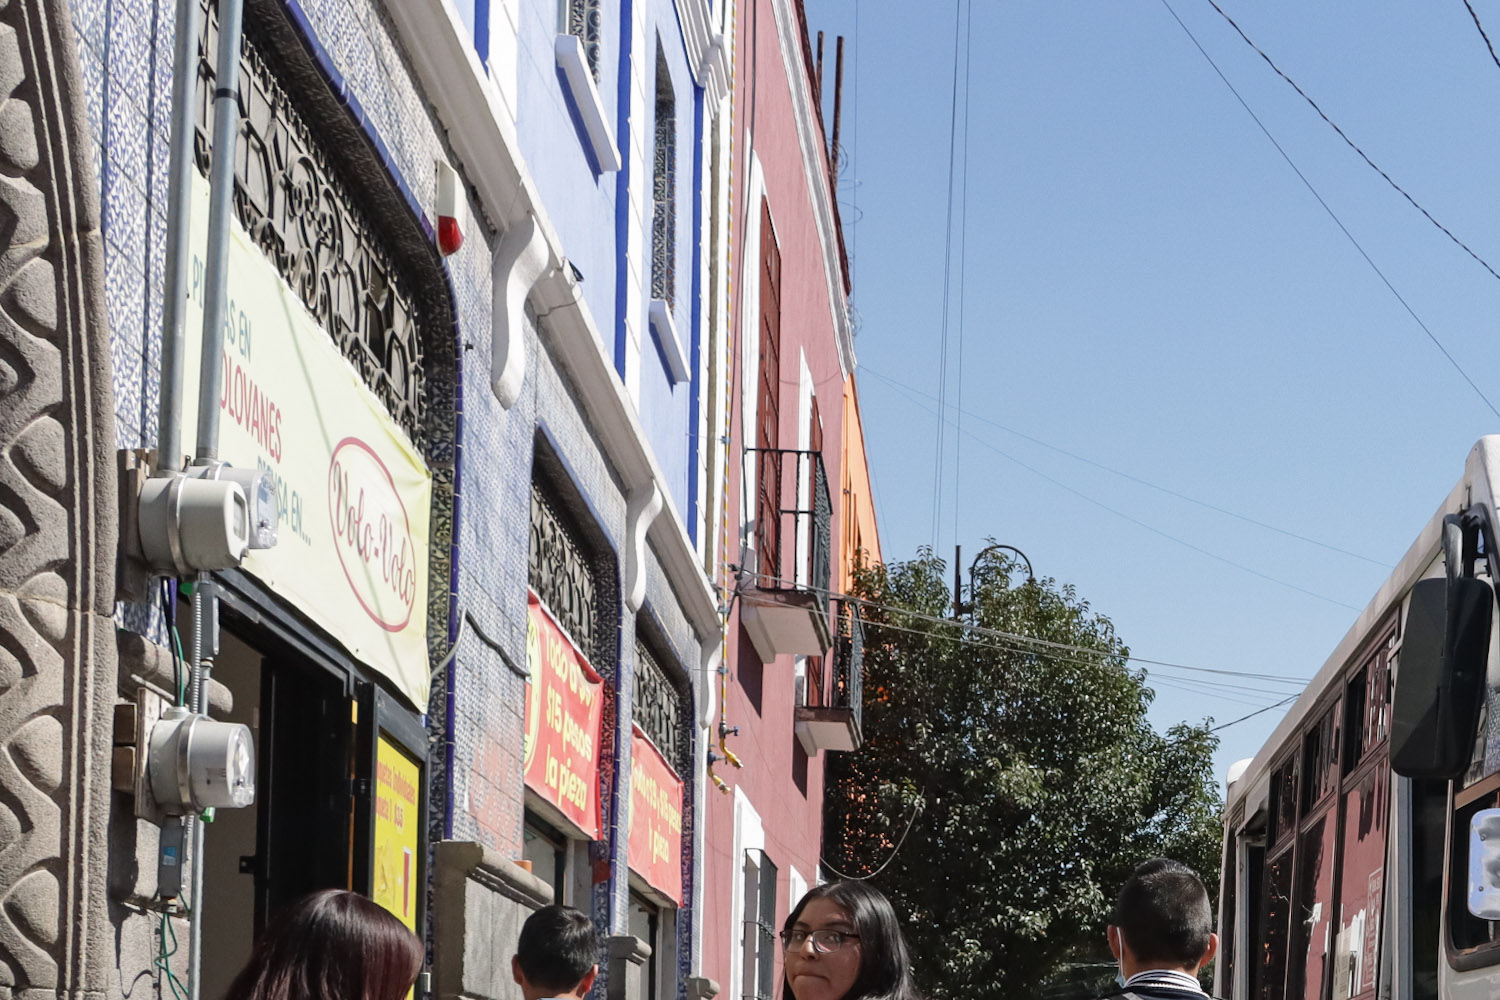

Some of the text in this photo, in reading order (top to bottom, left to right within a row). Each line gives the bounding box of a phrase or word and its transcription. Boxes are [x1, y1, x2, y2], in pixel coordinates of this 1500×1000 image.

[238, 309, 252, 364] EN
[543, 622, 568, 684] Todo
[546, 681, 562, 734] $15
[562, 709, 593, 763] pesos
[544, 743, 558, 790] la
[557, 757, 588, 812] pieza
